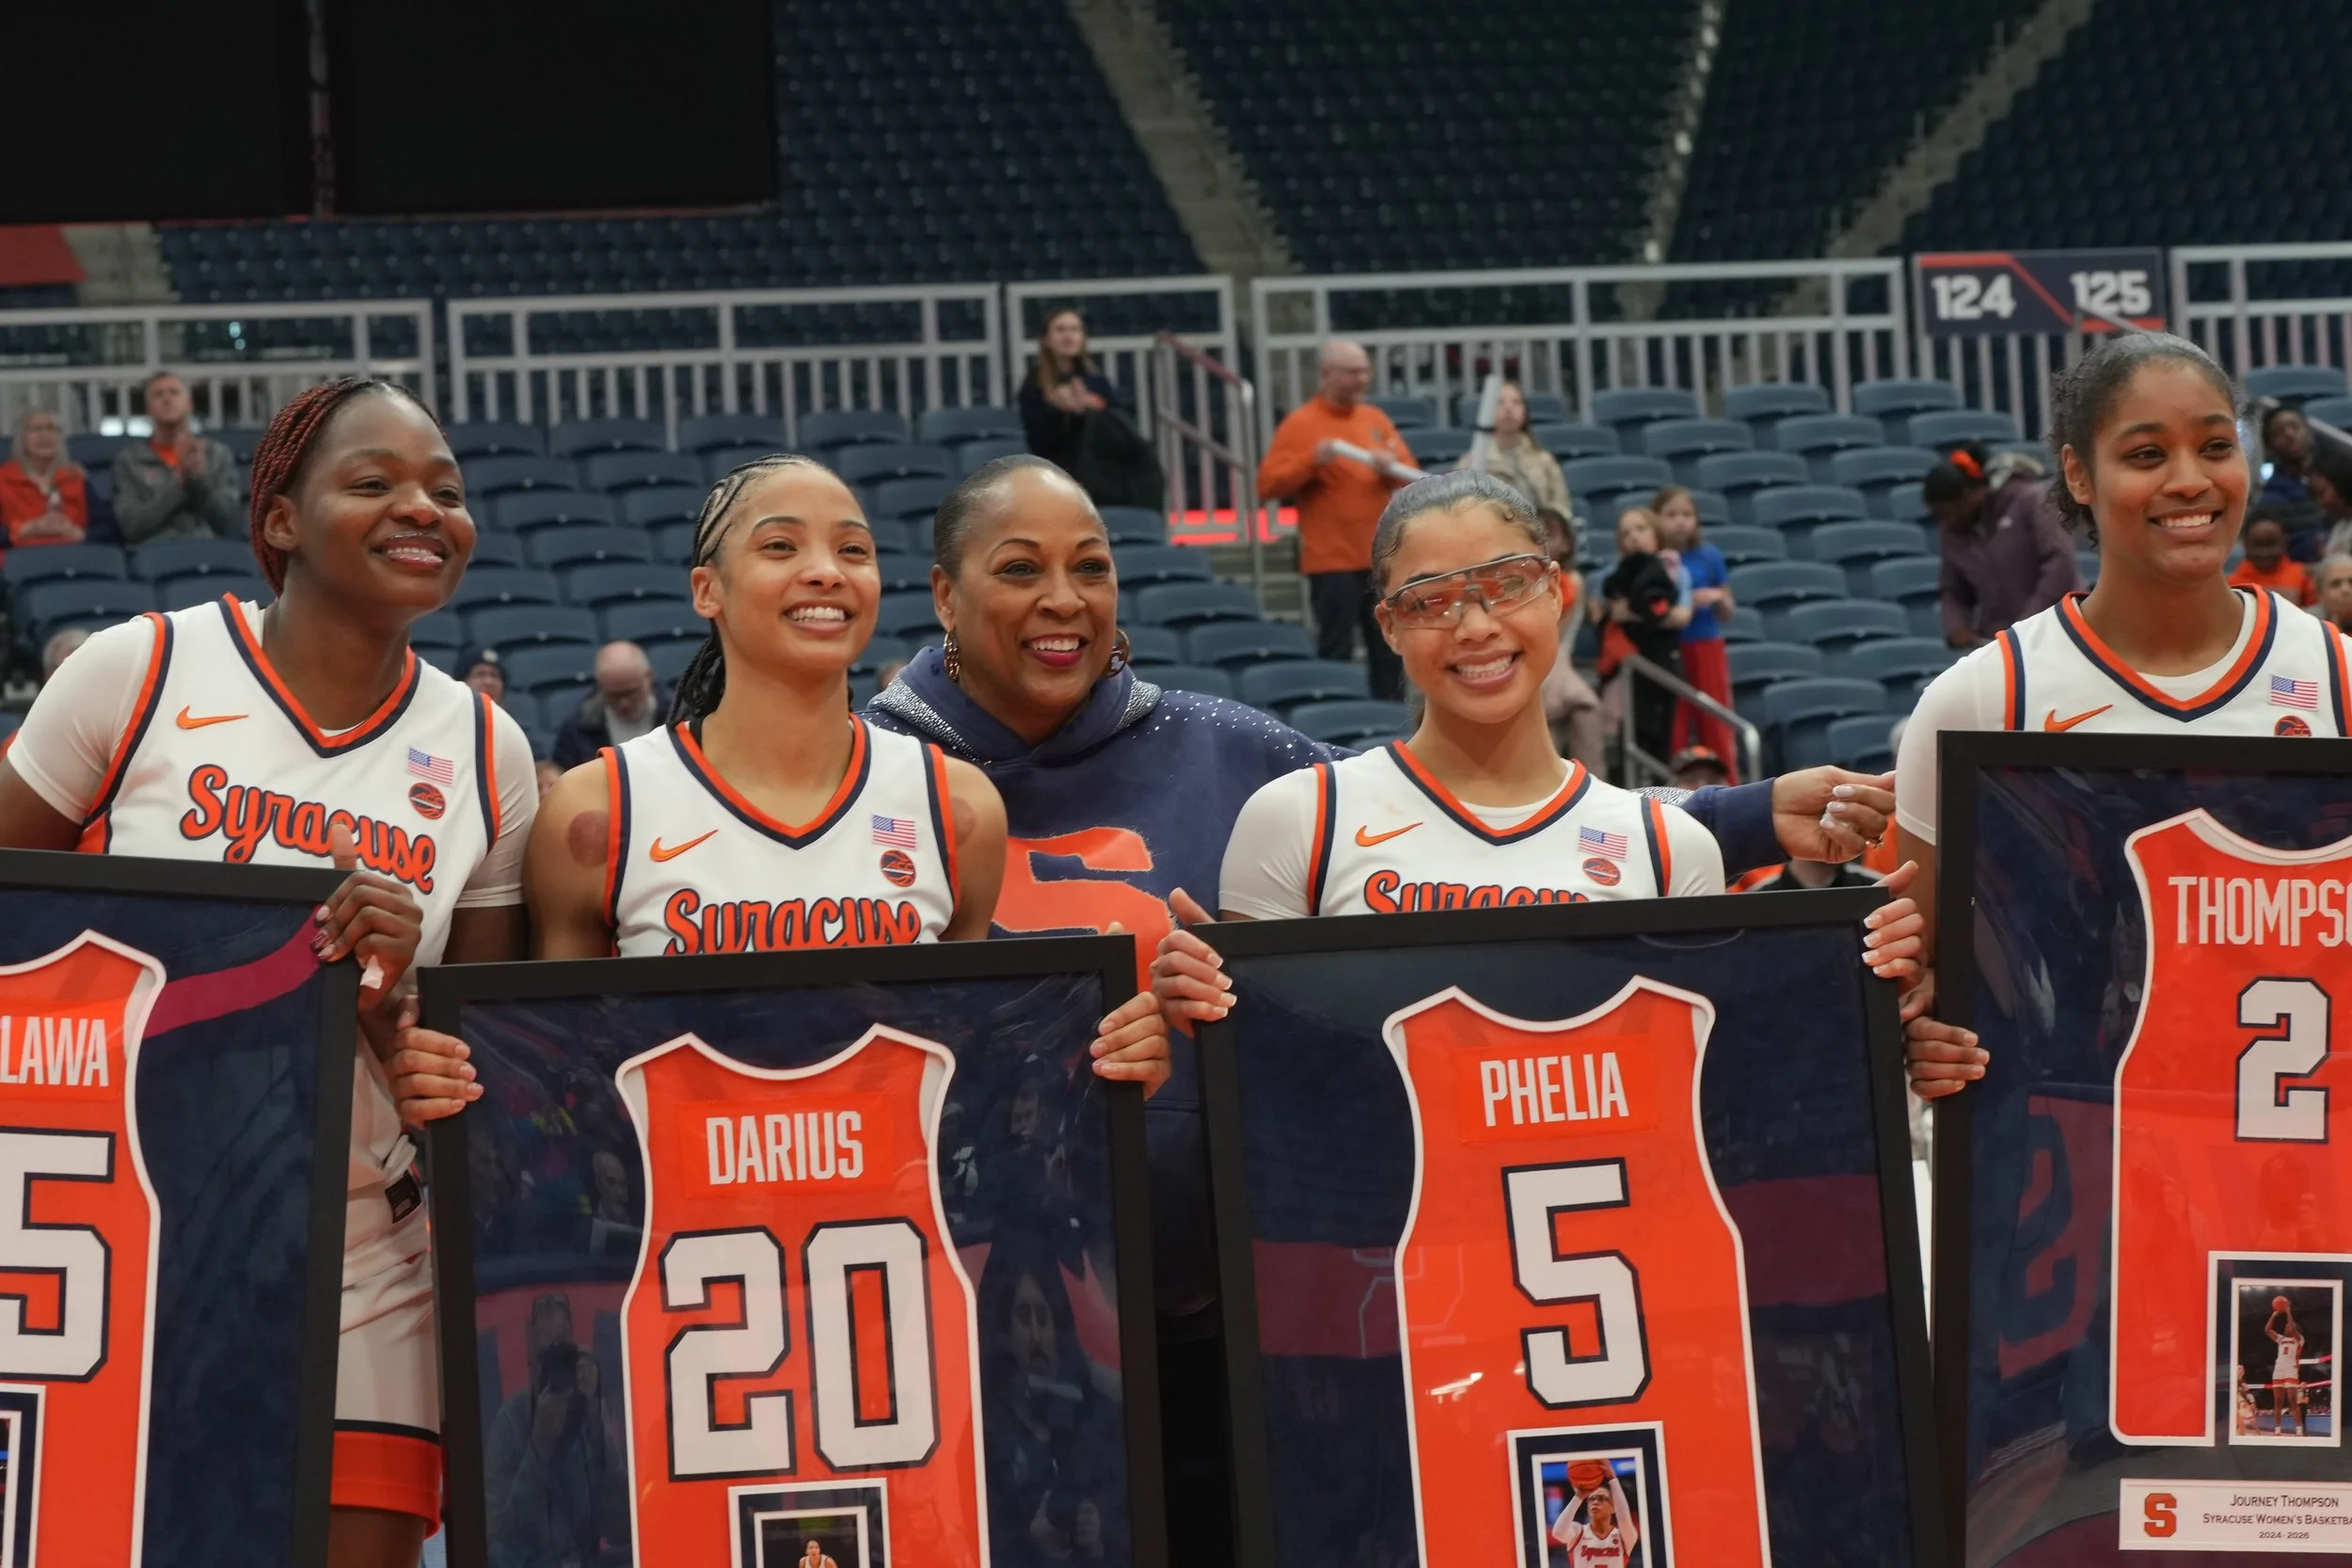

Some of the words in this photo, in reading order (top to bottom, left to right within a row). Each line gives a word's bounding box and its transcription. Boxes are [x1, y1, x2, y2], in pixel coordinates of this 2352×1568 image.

[1931, 274, 2016, 320] 124
[2070, 270, 2152, 315] 125
[180, 764, 436, 895] Syracuse
[2168, 876, 2352, 947] THOMPS
[1480, 1052, 1629, 1127] PHELIA
[2234, 976, 2330, 1144] 2
[707, 1111, 864, 1185] DARIUS
[0, 1127, 116, 1383] 5
[1501, 1157, 1652, 1410] 5
[658, 1216, 941, 1482] 20
[2144, 1493, 2177, 1538] S
